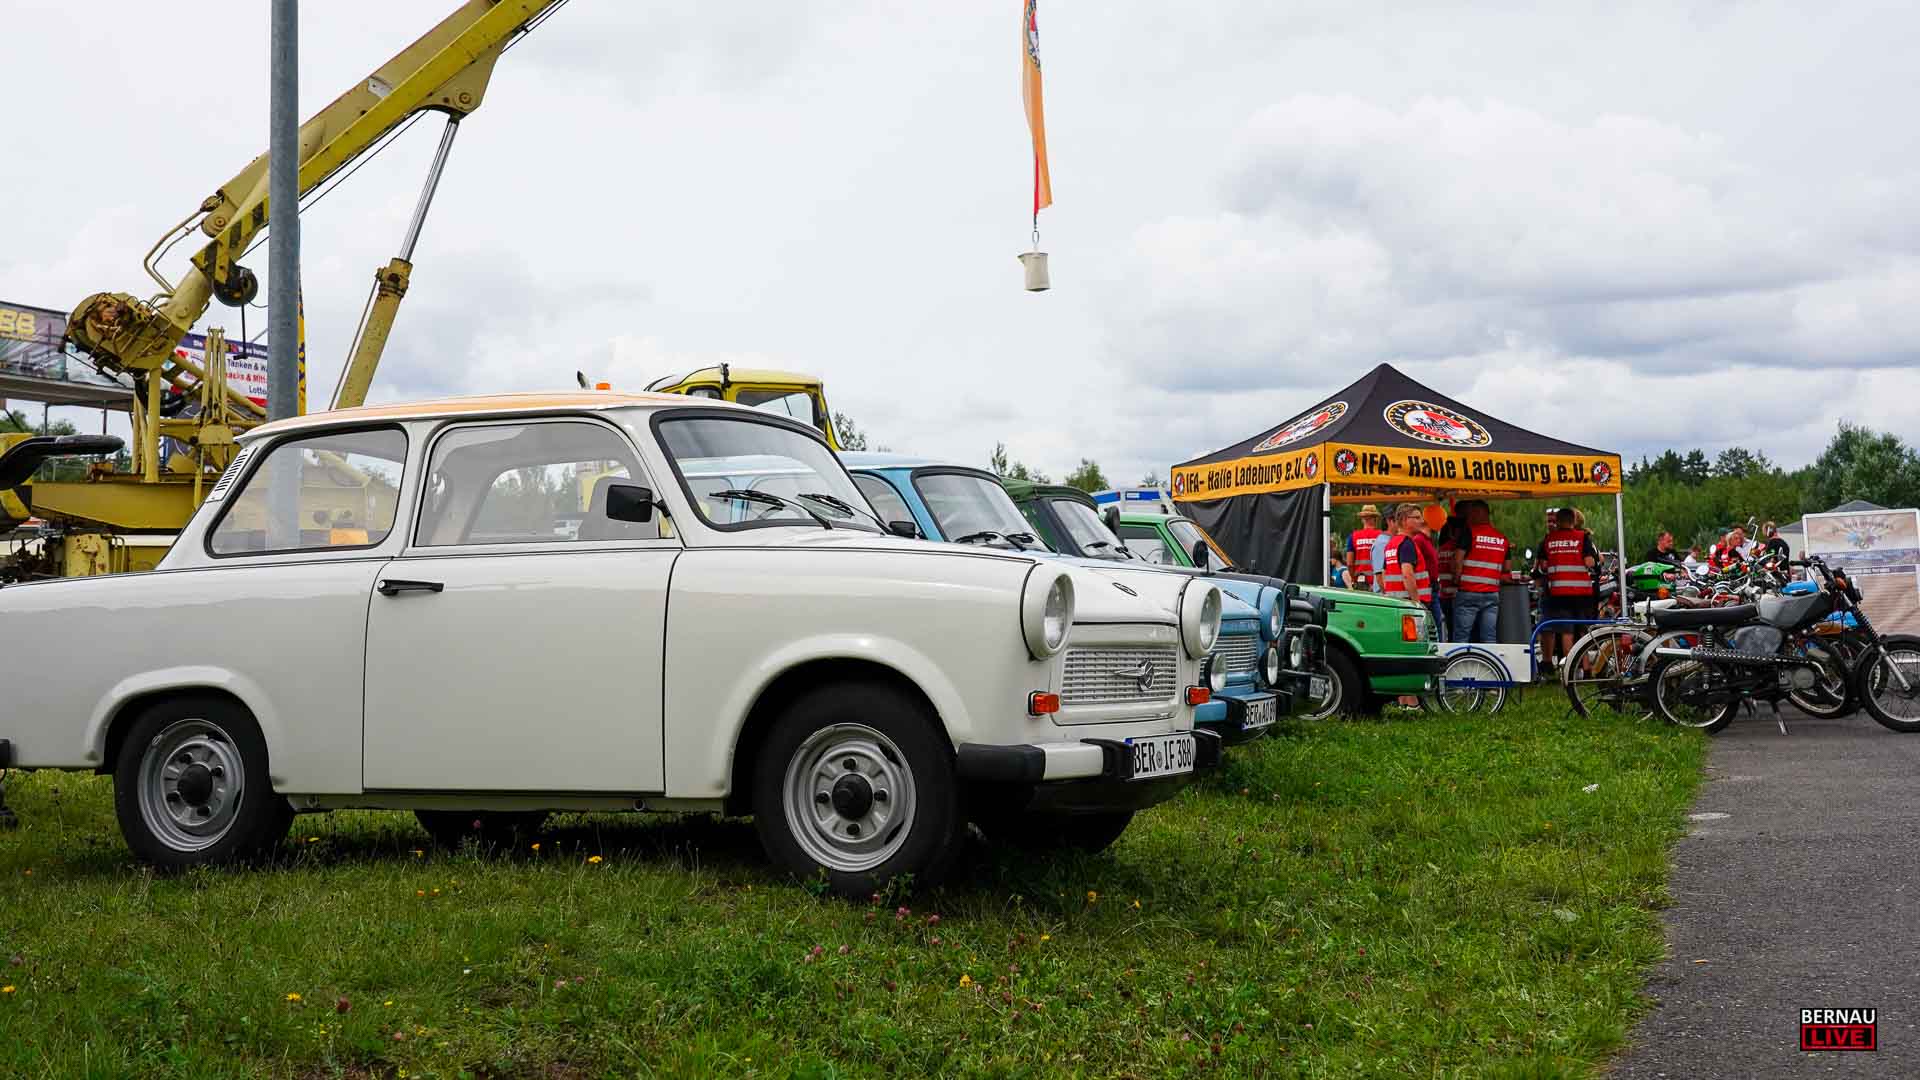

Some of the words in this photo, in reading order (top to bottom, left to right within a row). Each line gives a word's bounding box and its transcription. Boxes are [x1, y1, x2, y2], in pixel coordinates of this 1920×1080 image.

[227, 359, 253, 370] Tanken
[253, 363, 259, 371] &
[246, 373, 252, 382] &
[1408, 455, 1457, 479] Halle
[1463, 458, 1549, 484] Ladeburg
[1207, 467, 1232, 491] Halle
[1235, 463, 1283, 487] Ladeburg
[1476, 535, 1505, 545] CREW
[1548, 540, 1580, 548] CREW
[1134, 741, 1157, 773] BER
[1164, 740, 1175, 770] IF
[1176, 738, 1192, 768] 388
